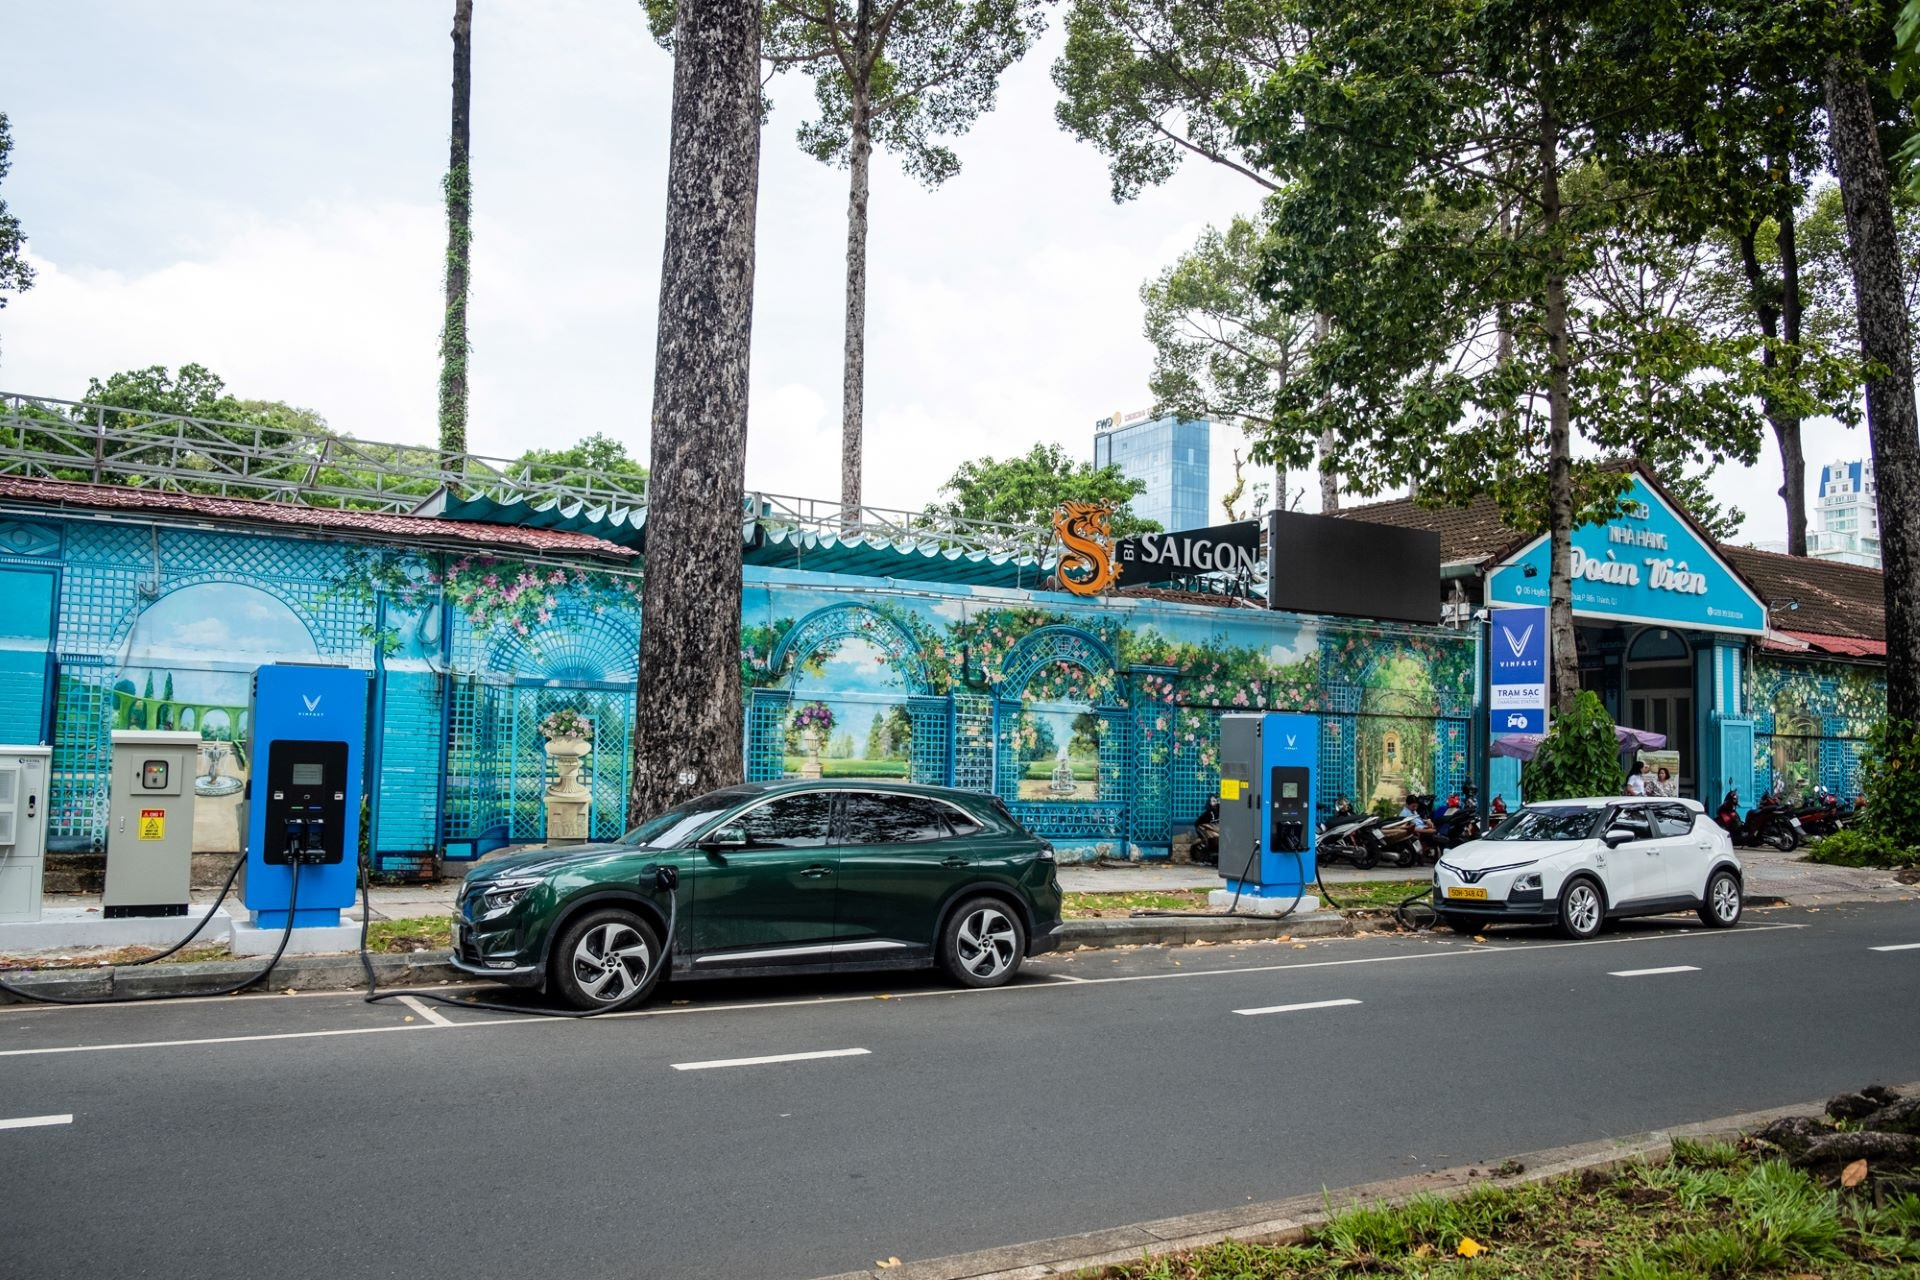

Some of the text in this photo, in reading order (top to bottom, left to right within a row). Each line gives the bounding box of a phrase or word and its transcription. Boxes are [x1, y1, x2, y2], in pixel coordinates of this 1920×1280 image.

[1095, 416, 1113, 431] FWD
[1123, 533, 1134, 561] BIA
[1608, 523, 1668, 551] NHÀ HÀNG
[1140, 531, 1257, 576] SAIGON
[1169, 571, 1251, 600] SPECIAL
[1643, 558, 1708, 595] Viên
[1499, 659, 1538, 668] VINFAST
[1497, 688, 1540, 699] TRẠM SẠC
